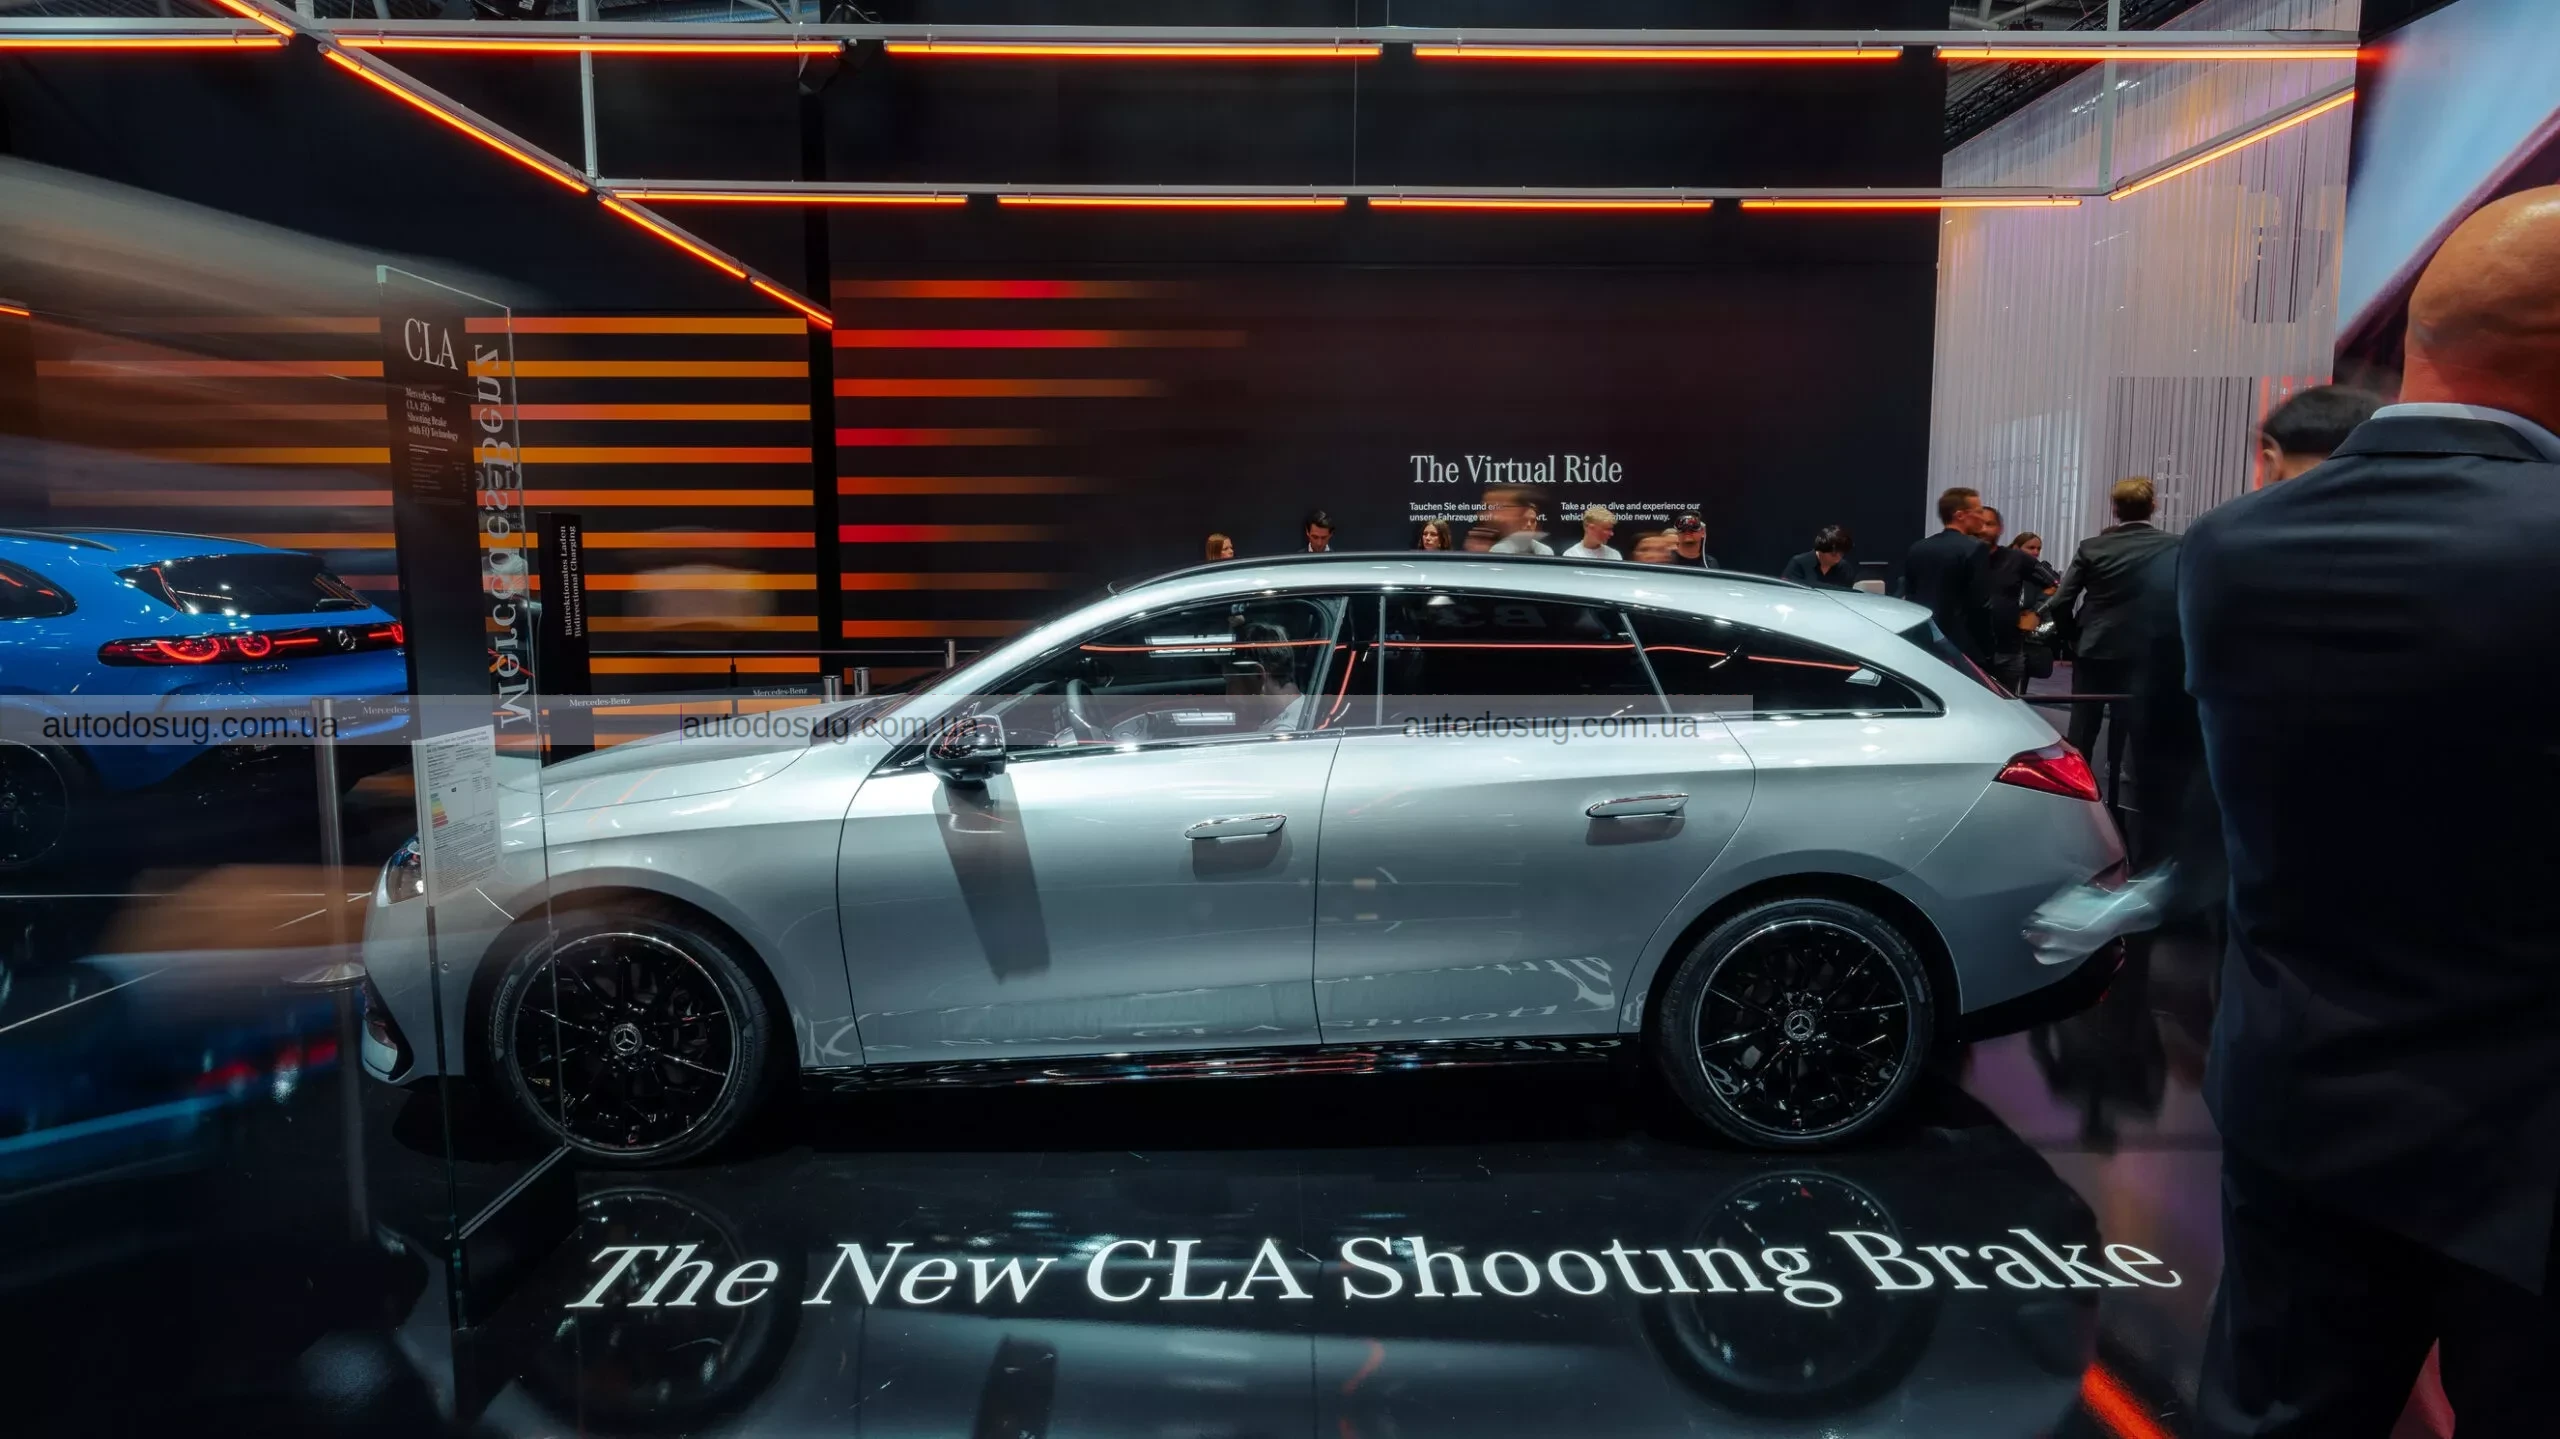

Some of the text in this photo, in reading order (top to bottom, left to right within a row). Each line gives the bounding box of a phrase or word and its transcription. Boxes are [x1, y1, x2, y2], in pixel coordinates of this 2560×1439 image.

[405, 318, 458, 370] CLA
[406, 400, 419, 411] CLA
[406, 411, 448, 427] Shooting Brake
[408, 425, 421, 436] with
[1410, 455, 1622, 483] The Virtual Ride
[1409, 502, 1443, 511] Tauchen
[1443, 502, 1457, 511] Sie
[1457, 502, 1470, 511] ein
[1471, 502, 1487, 511] und
[1560, 502, 1580, 510] Take
[1607, 501, 1625, 510] dive
[1626, 501, 1641, 510] and
[1642, 502, 1686, 511] experience
[1437, 512, 1478, 523] Fahrzeuge
[1560, 512, 1584, 521] vehicl
[1613, 512, 1634, 521] hole
[1652, 514, 1670, 523] way.
[560, 526, 573, 636] Bidirektionales Laden
[569, 526, 581, 637] Bidirectional Charging
[752, 687, 808, 697] Mercedes-Benz
[569, 697, 631, 707] Mercedes-Benz
[363, 706, 410, 715] Mercedes-
[563, 1227, 2184, 1309] The New CLA Shooting Brake
